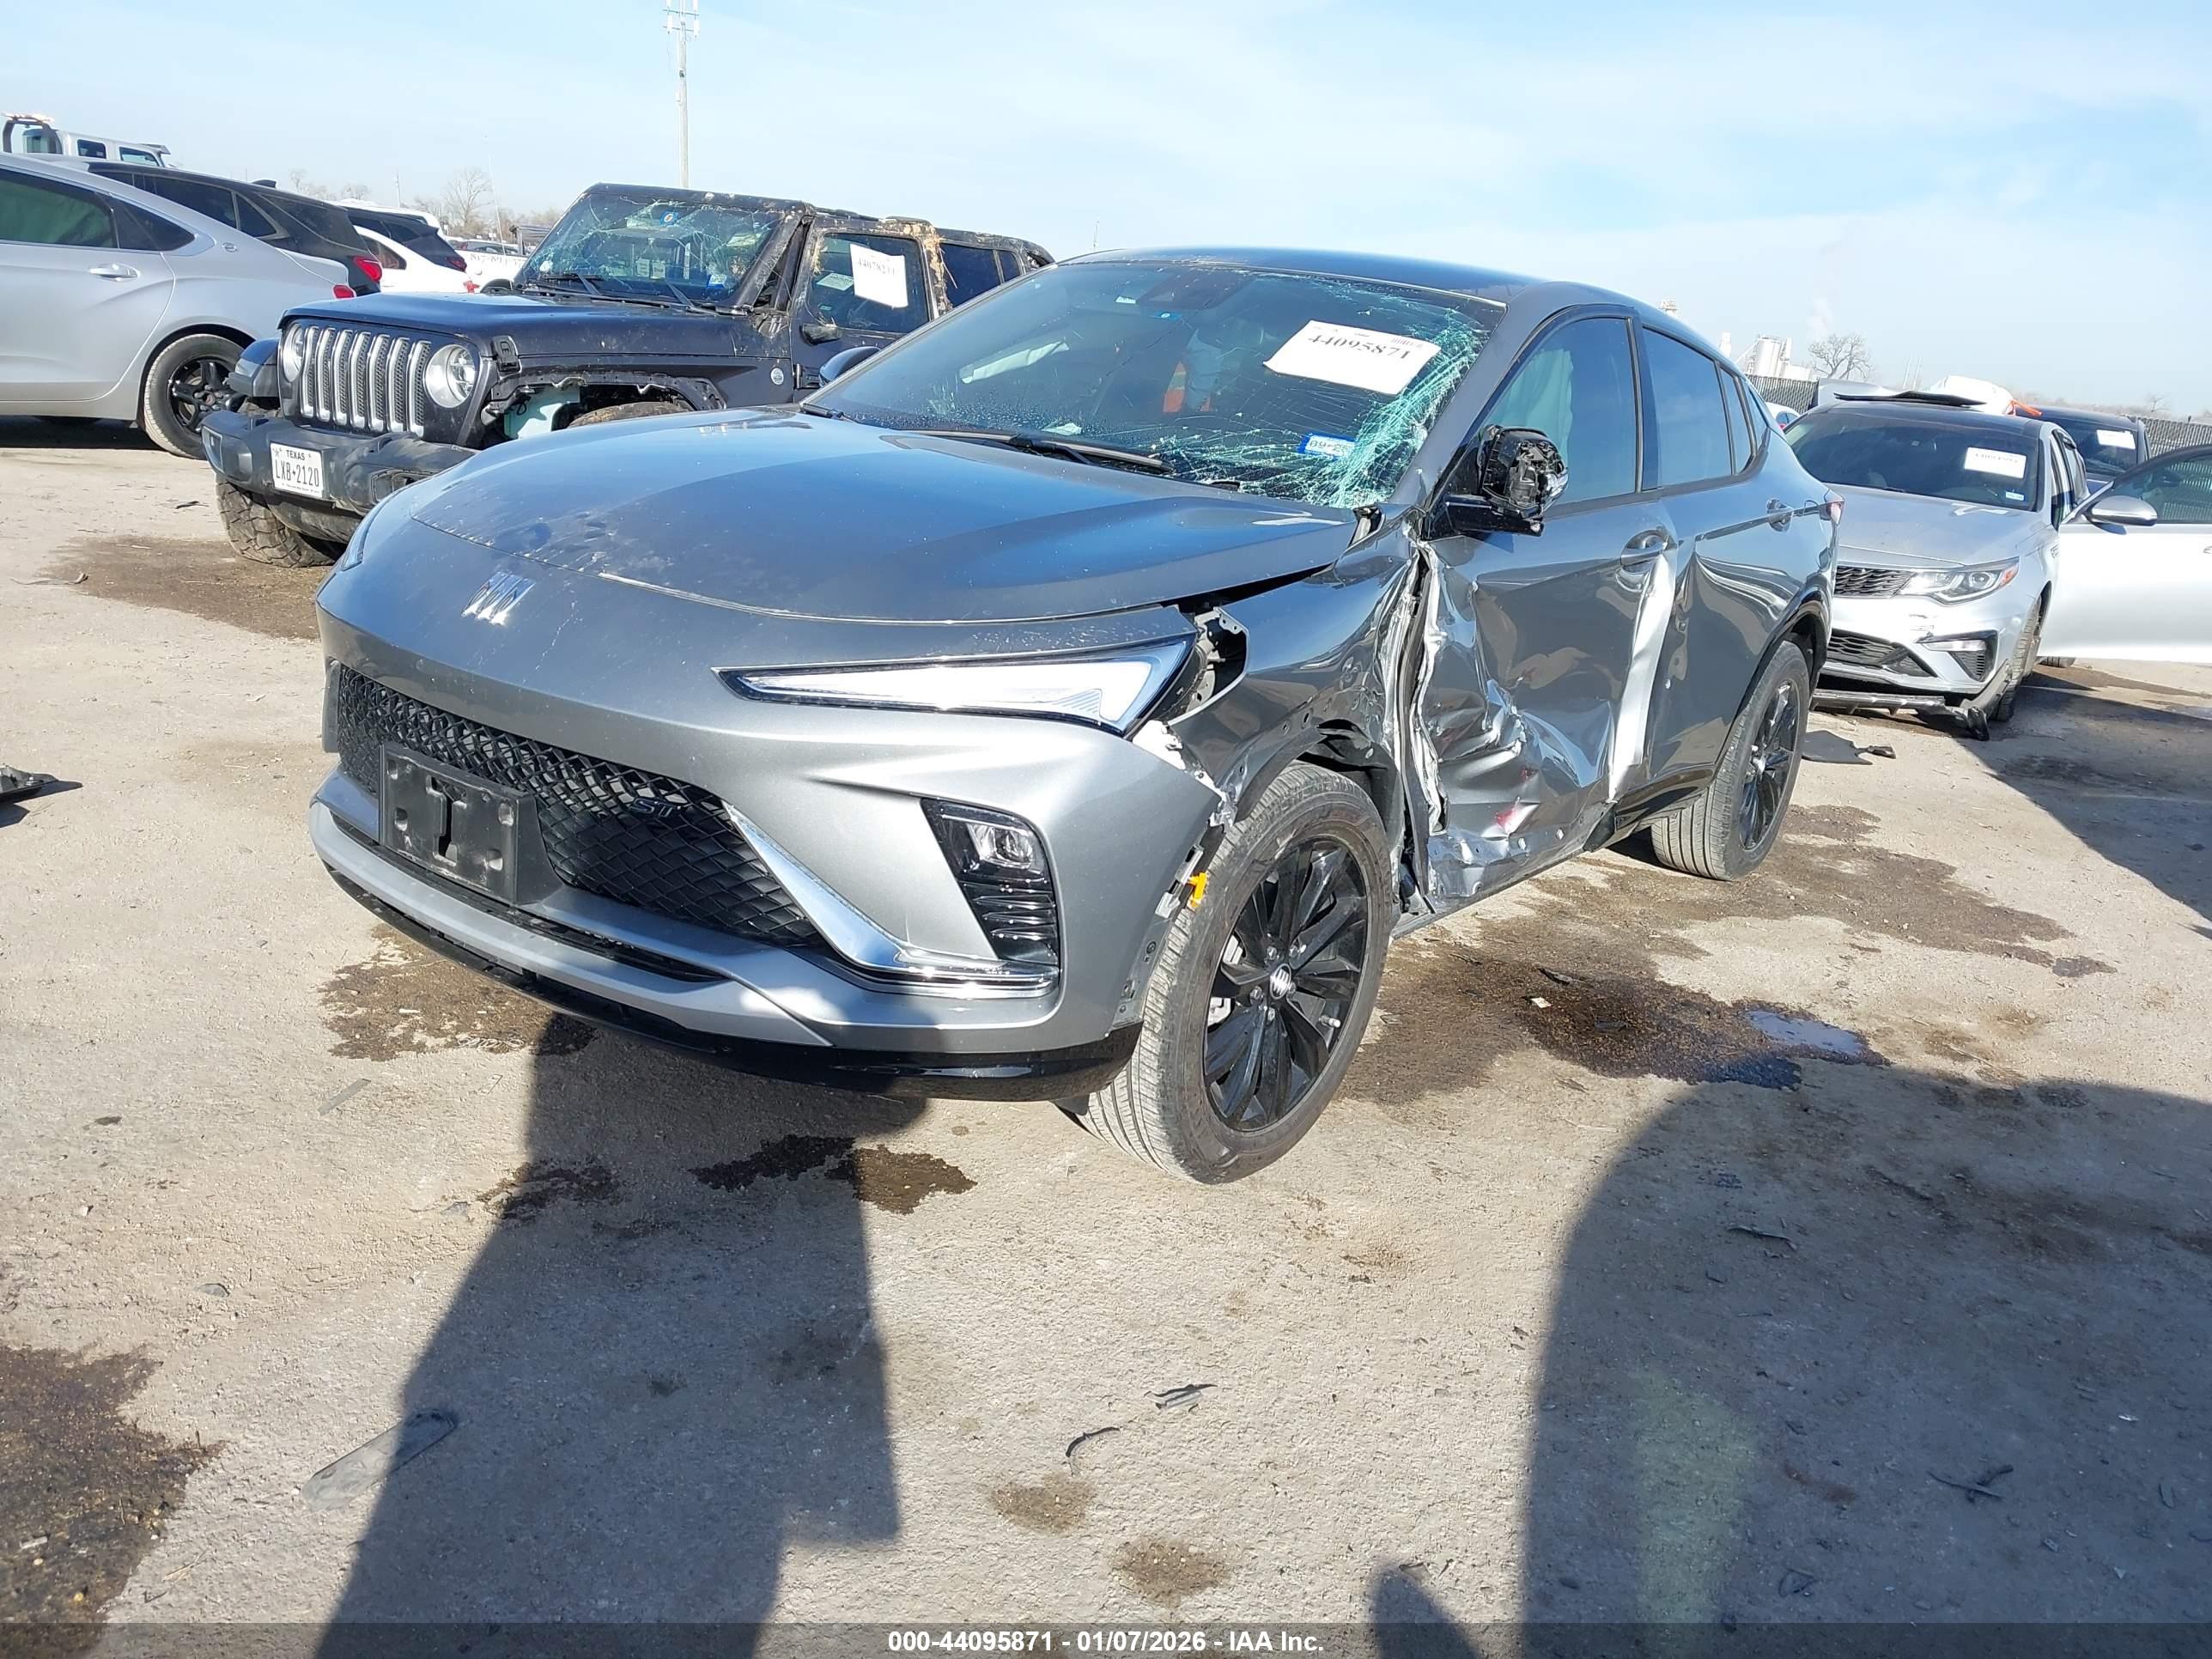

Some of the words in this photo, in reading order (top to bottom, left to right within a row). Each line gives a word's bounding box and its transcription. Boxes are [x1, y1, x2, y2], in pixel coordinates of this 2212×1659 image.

[1308, 334, 1411, 360] 44095871
[286, 449, 306, 461] TEXAS
[631, 798, 674, 818] ST
